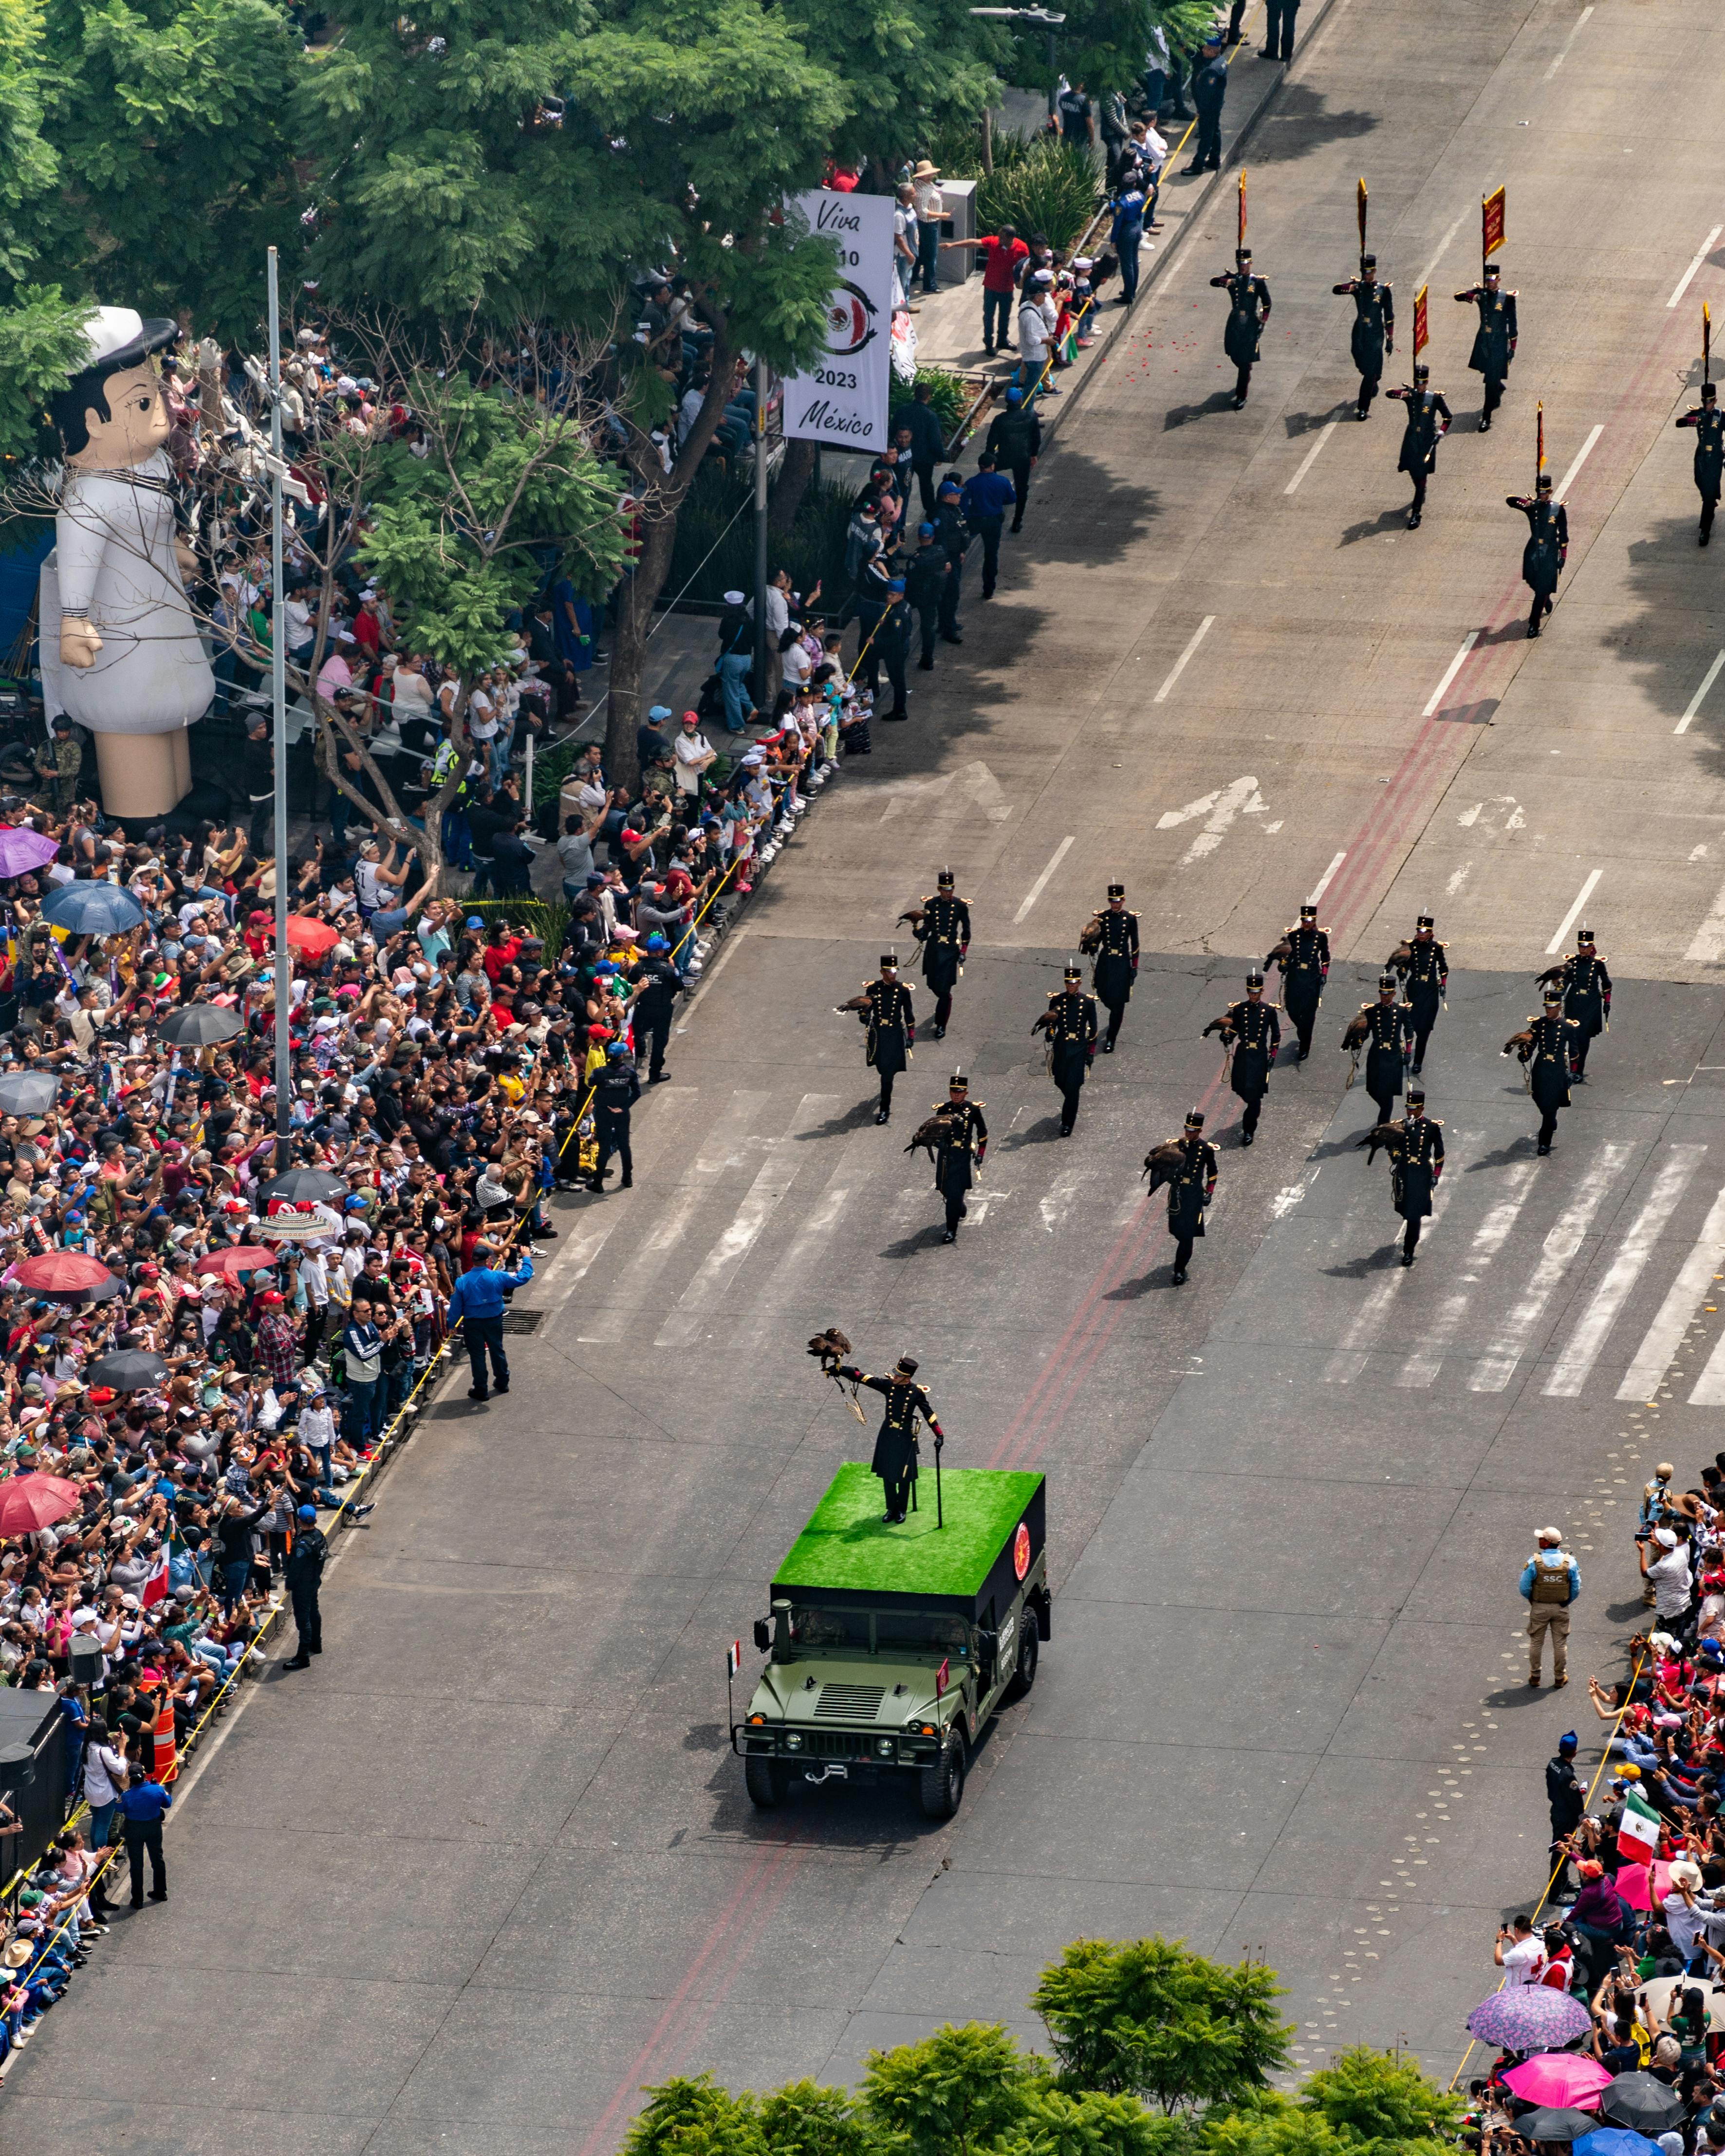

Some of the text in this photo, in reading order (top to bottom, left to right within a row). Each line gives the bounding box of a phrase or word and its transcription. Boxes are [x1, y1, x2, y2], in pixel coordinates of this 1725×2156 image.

[817, 200, 860, 231] Viva
[815, 369, 857, 388] 2023
[798, 400, 873, 436] México
[355, 869, 366, 889] 21
